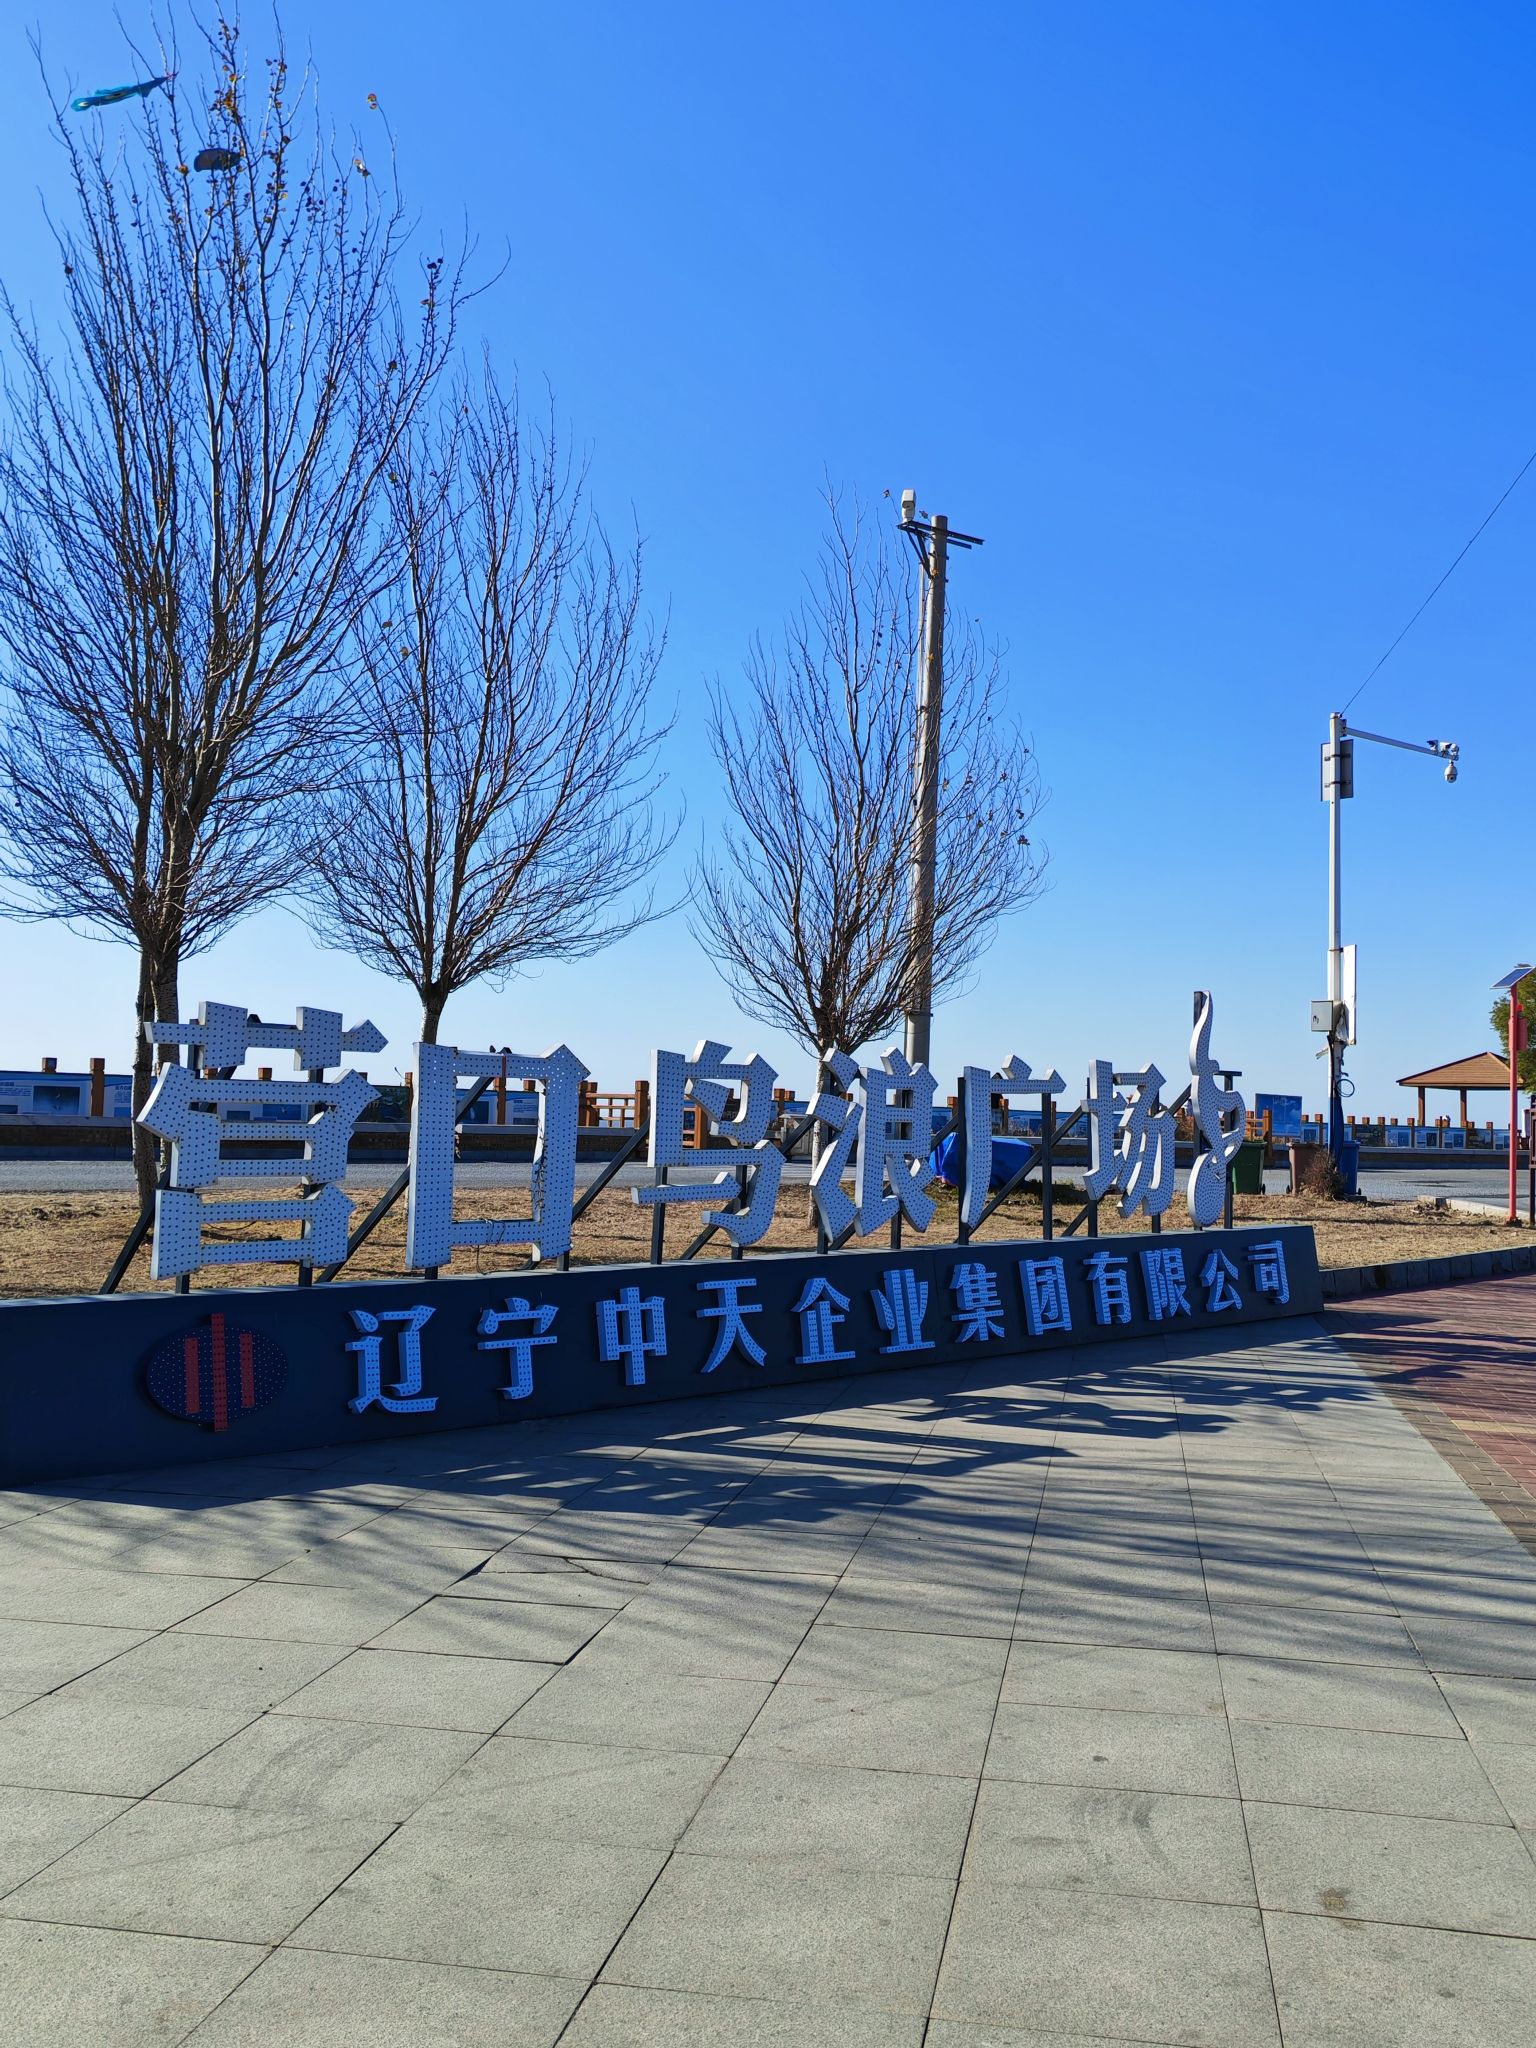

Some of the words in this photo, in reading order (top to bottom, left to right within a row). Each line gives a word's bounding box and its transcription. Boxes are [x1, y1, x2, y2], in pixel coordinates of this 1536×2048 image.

[136, 1001, 1177, 1281] 营口鸟浪广场
[345, 1240, 1290, 1415] 辽宁中天企业集团有限公司
